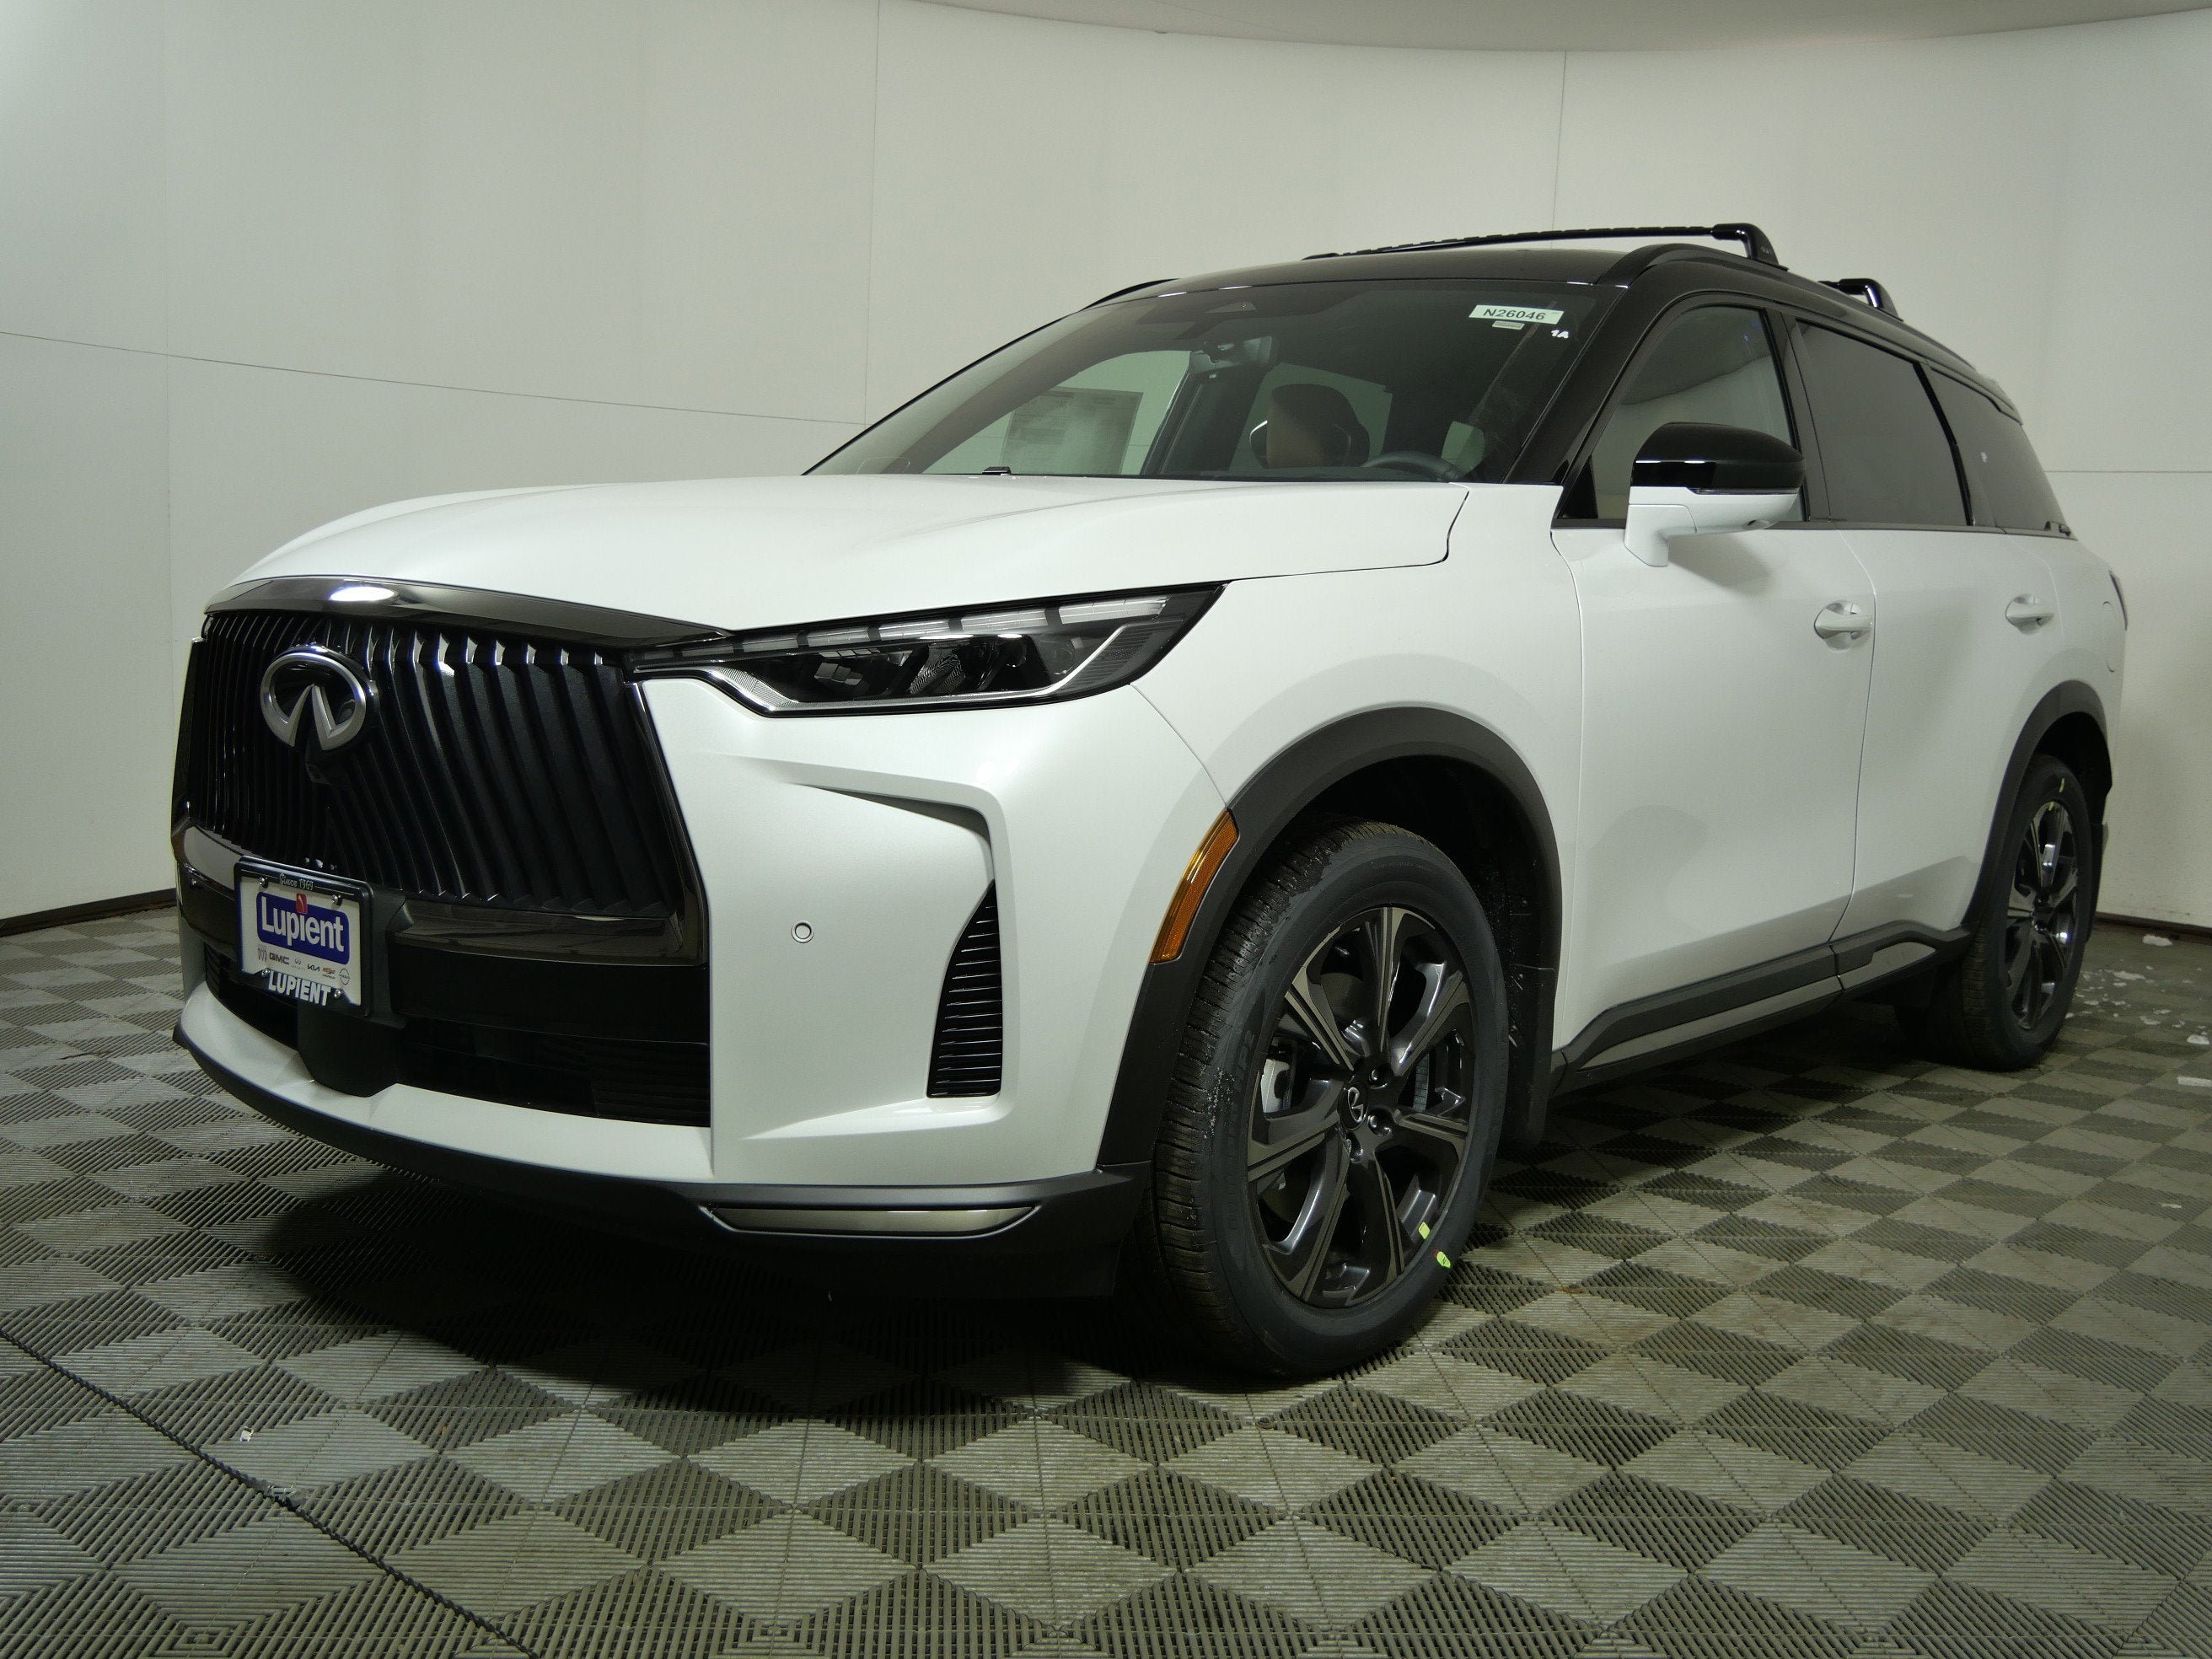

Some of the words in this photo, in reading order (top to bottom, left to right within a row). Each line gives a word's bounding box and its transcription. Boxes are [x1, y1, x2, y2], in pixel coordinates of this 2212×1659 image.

[1484, 309, 1546, 320] N26046
[279, 872, 298, 887] Since
[299, 878, 314, 890] 1969
[261, 896, 344, 952] Lupient
[269, 953, 289, 964] GMC
[268, 970, 331, 1006] LUPIENT
